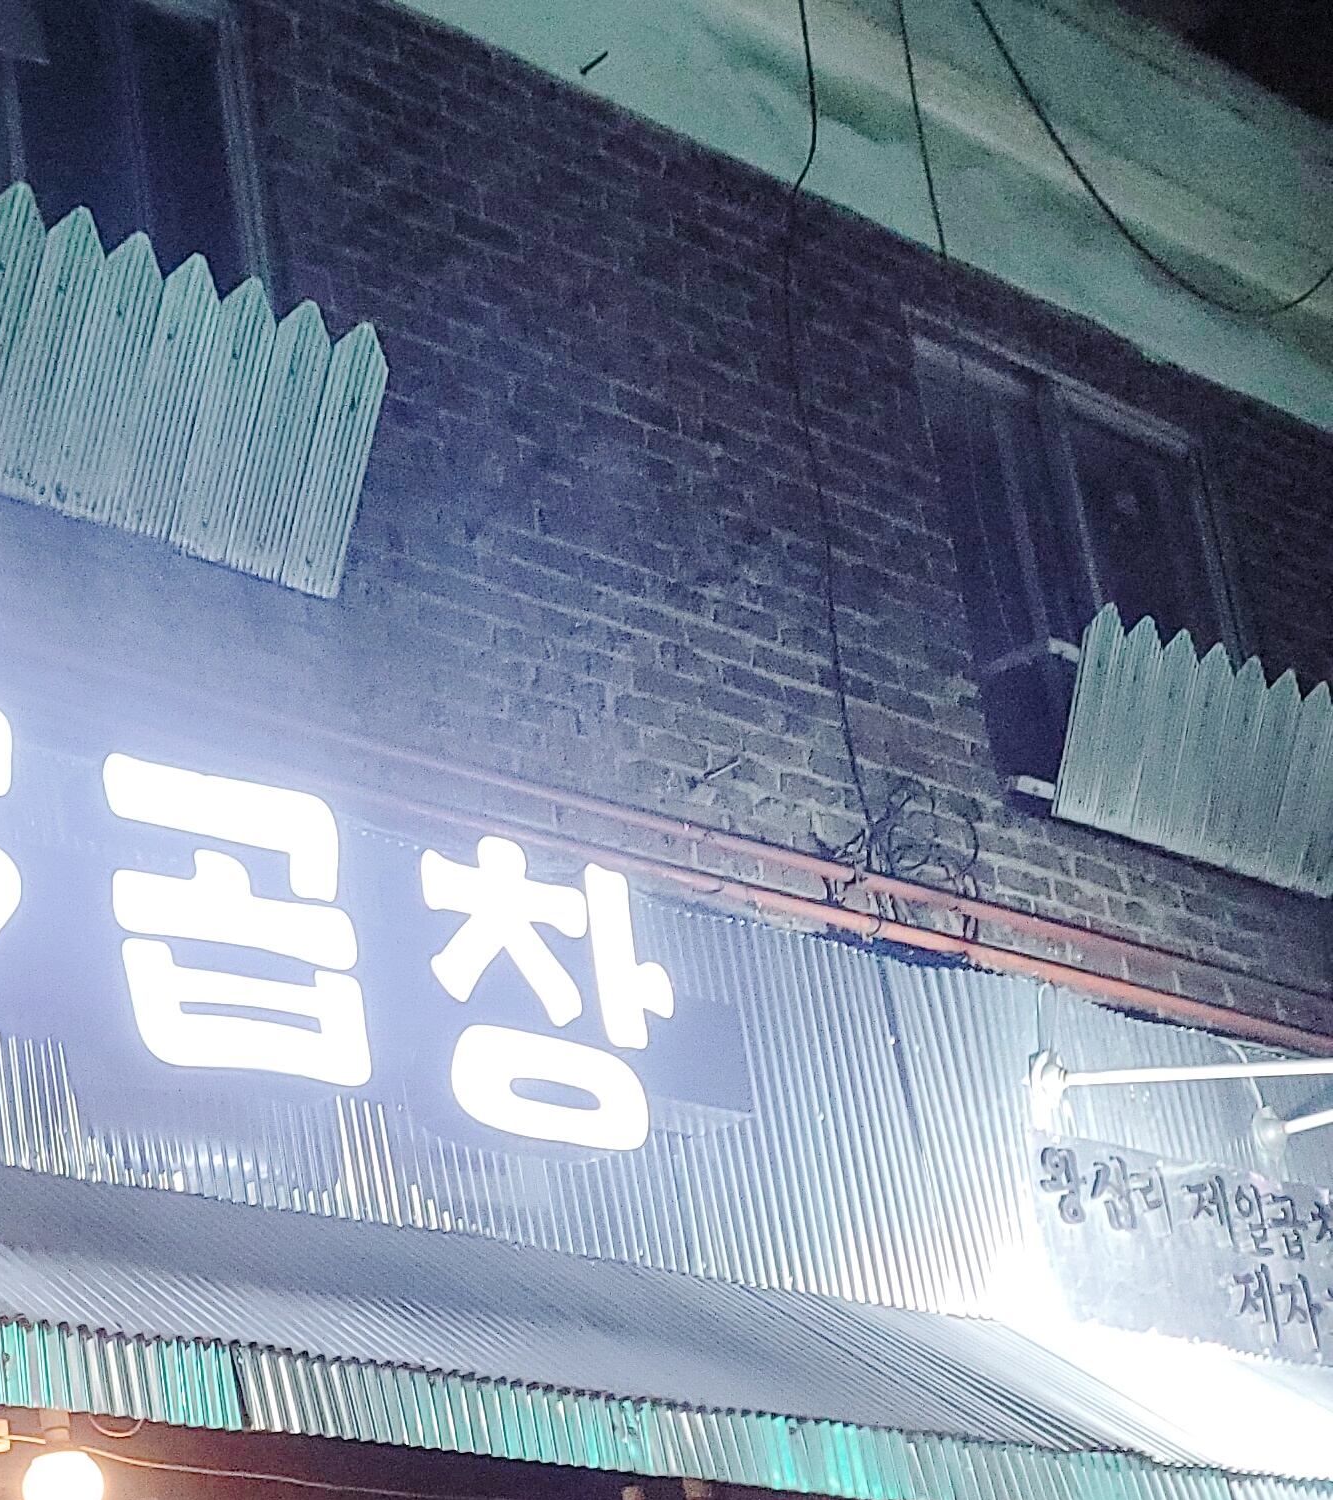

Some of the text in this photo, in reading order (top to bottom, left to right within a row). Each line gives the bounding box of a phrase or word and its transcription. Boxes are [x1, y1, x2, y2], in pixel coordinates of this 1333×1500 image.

[102, 752, 675, 1152] 곱창
[1039, 1147, 1173, 1236] 왕십리
[1233, 1263, 1333, 1351] 제자
